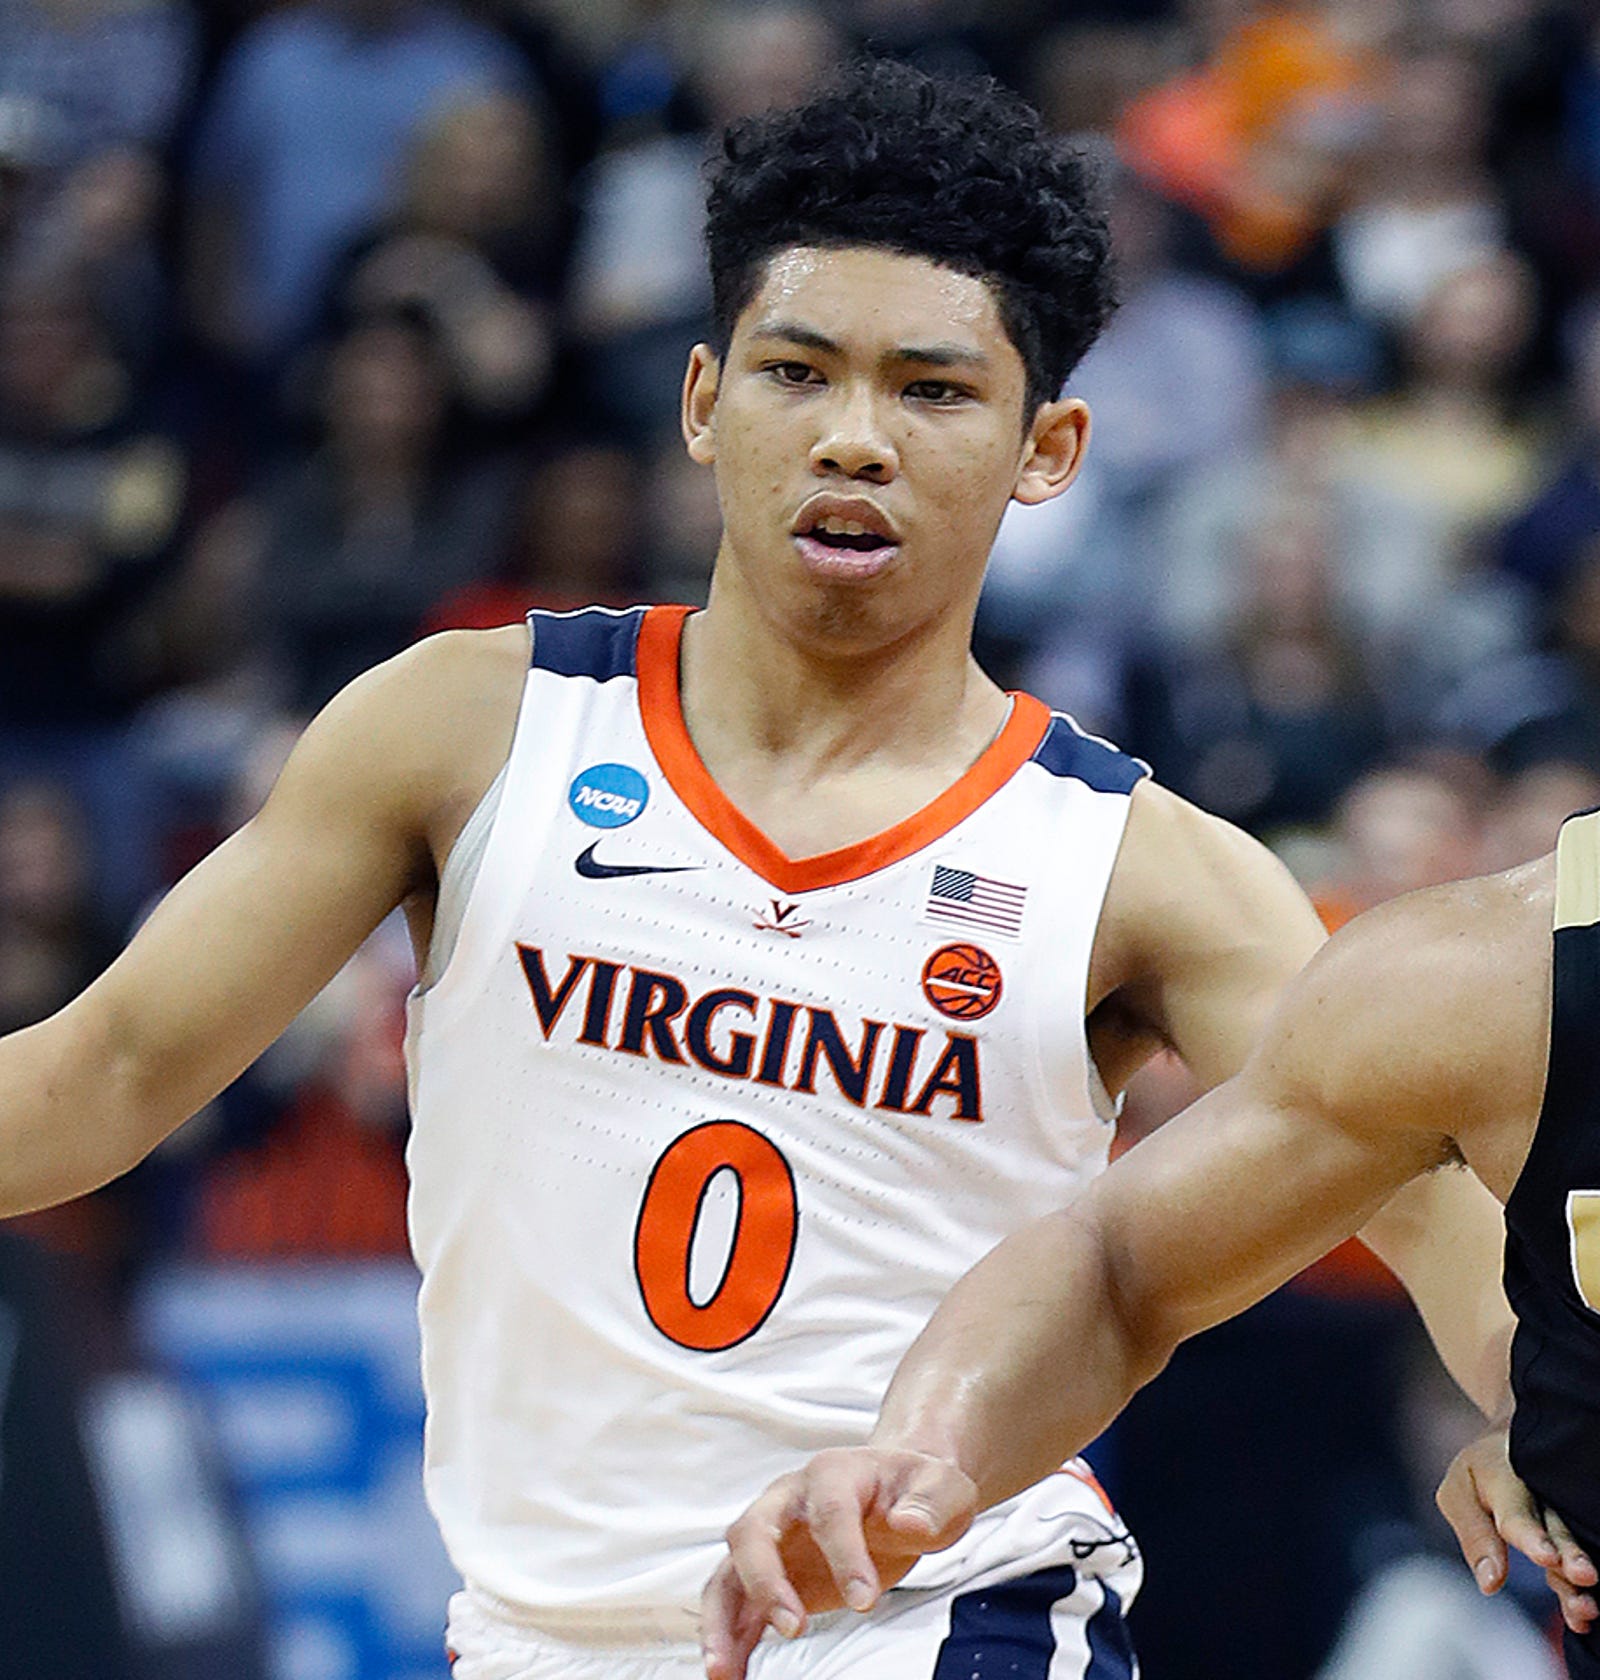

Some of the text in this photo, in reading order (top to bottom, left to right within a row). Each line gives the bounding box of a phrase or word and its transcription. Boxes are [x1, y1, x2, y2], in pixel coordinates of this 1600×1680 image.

[574, 785, 641, 818] NCAA
[514, 941, 985, 1123] VIRGINIA
[936, 966, 1000, 992] ACC
[634, 1119, 799, 1353] 0
